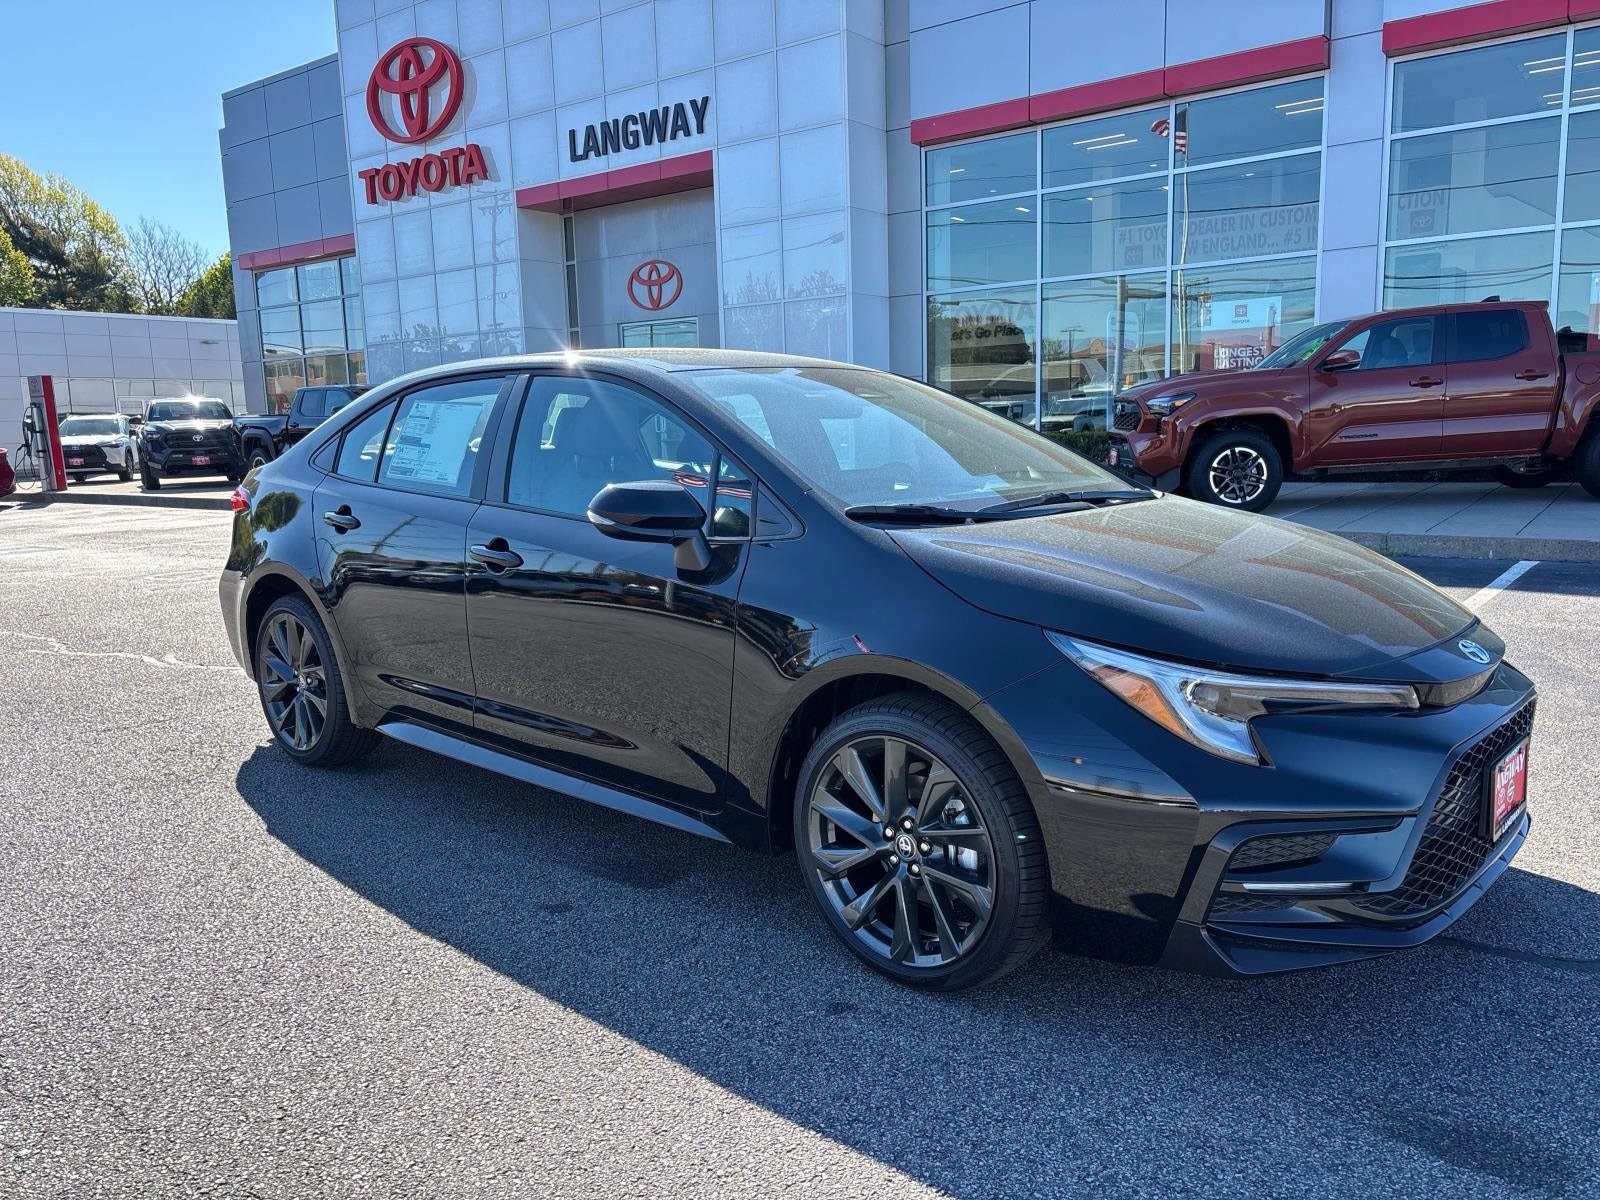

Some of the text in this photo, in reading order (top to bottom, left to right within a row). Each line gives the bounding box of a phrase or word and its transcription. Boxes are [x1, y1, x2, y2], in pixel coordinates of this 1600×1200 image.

[568, 96, 710, 162] LANGWAY
[358, 144, 489, 205] TOYOTA
[1189, 216, 1236, 237] DEALER
[1240, 213, 1254, 231] IN
[1259, 205, 1317, 226] CUSTOM
[1284, 228, 1301, 245] #5
[975, 327, 991, 339] Go
[1214, 345, 1266, 358] LONGEST
